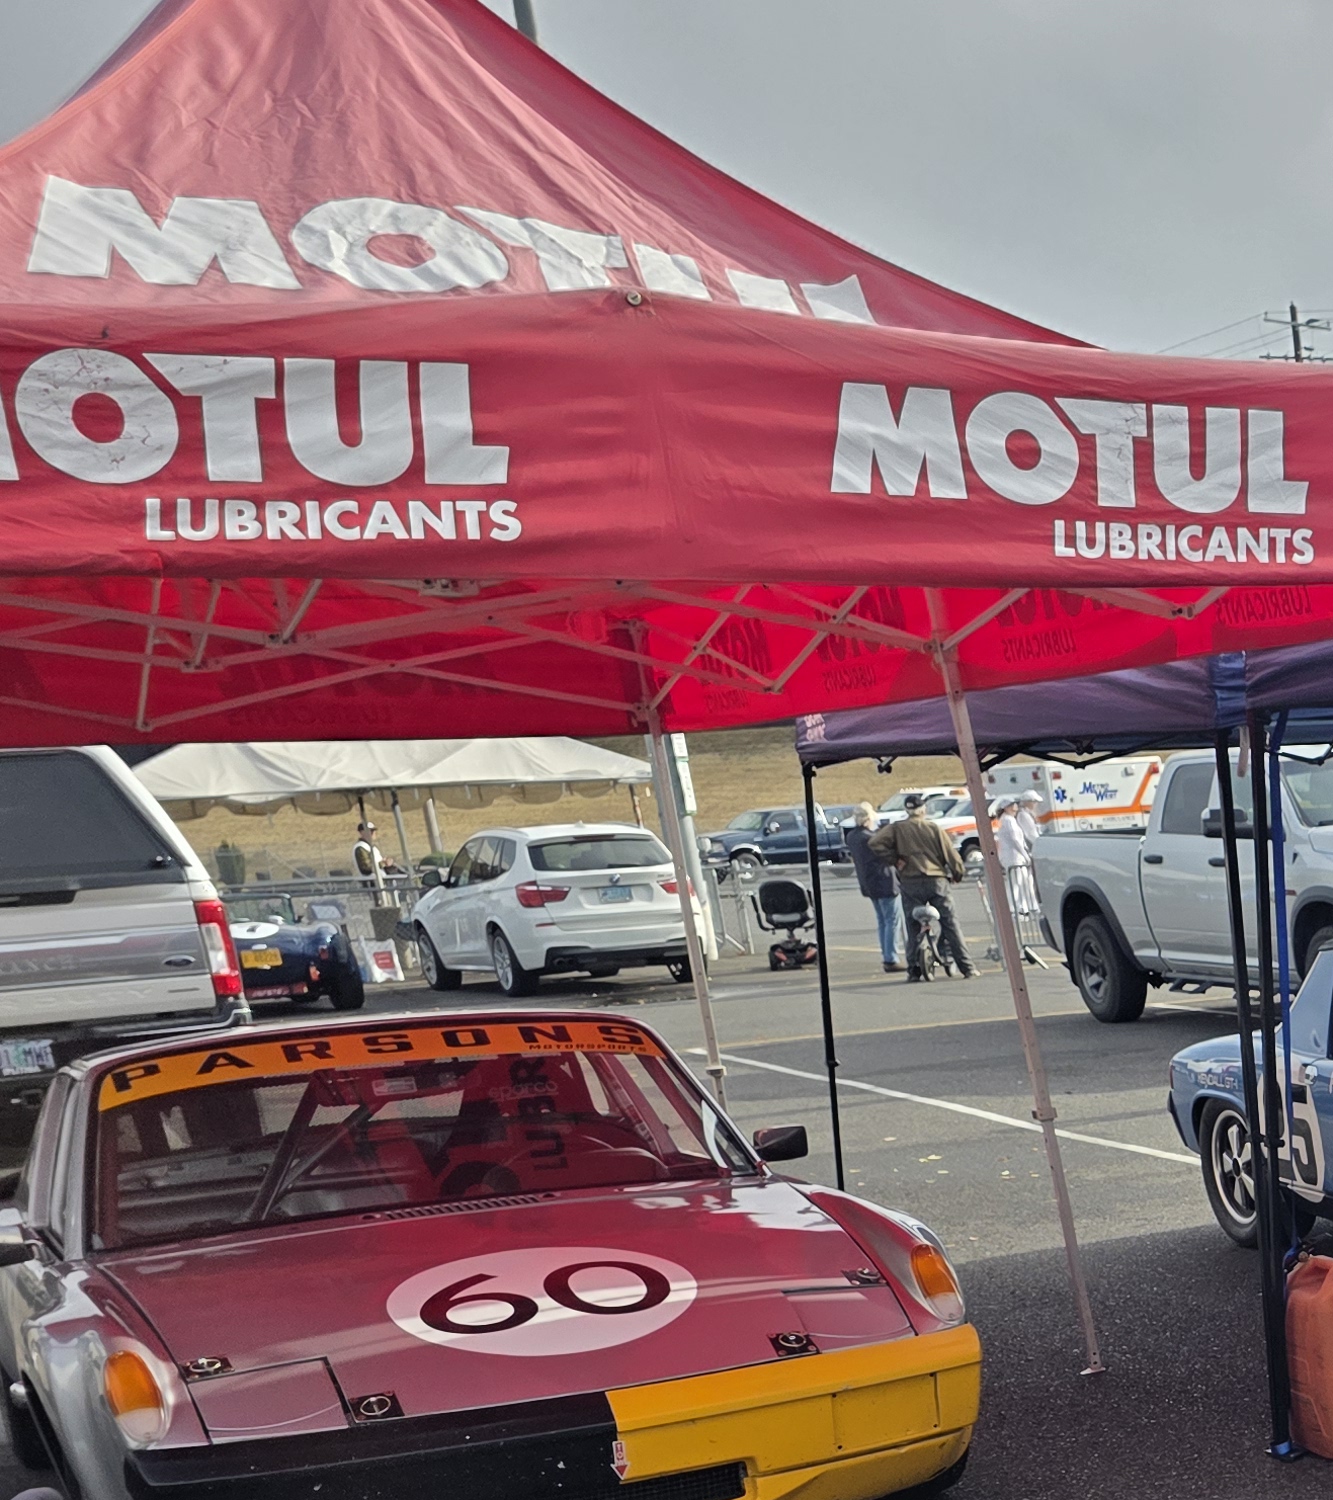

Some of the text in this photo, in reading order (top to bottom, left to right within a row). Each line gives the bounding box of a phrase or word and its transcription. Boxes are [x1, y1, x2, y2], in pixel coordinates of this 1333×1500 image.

[0, 348, 510, 487] OTUL
[831, 382, 1310, 514] MOTUL
[145, 499, 523, 543] LUBRICANTS
[1053, 519, 1315, 566] LUBRICANTS
[110, 1024, 646, 1093] PARSONS
[528, 1042, 647, 1053] MOTORSPORTS
[419, 1259, 671, 1335] 60
